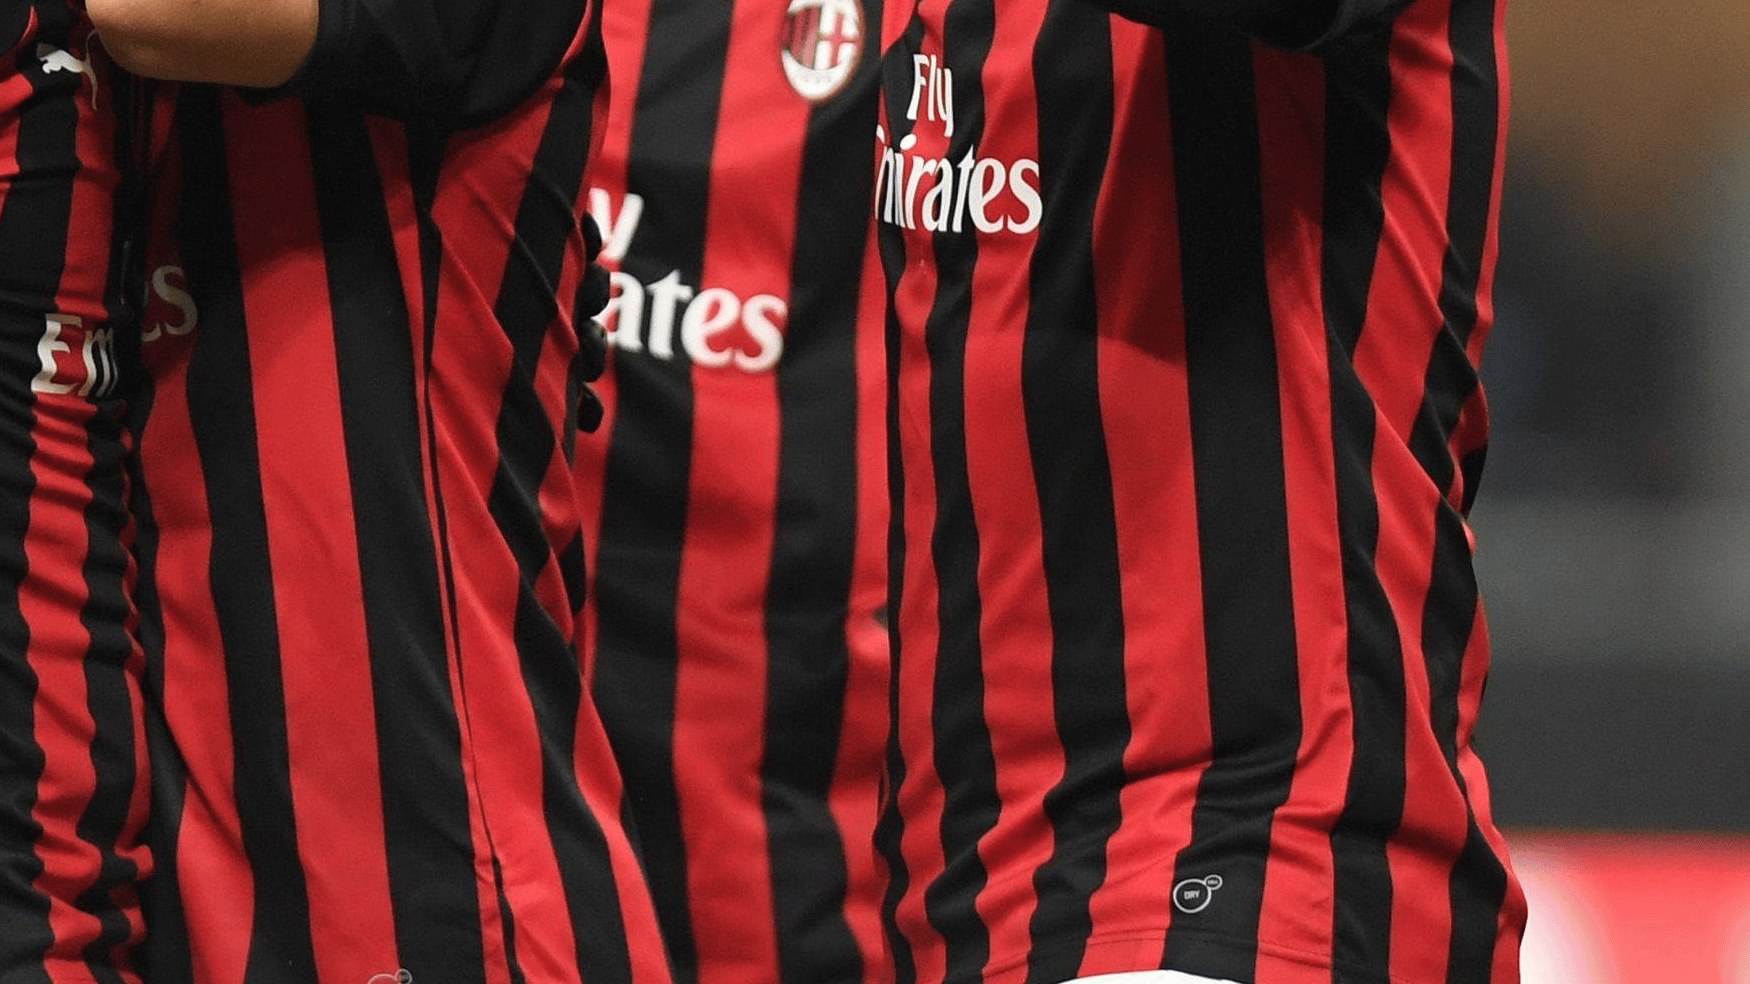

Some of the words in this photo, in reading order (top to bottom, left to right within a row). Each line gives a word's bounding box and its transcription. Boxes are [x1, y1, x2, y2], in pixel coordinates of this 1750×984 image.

[906, 54, 954, 137] Fly
[874, 125, 1043, 234] mirates
[590, 269, 788, 373] ates
